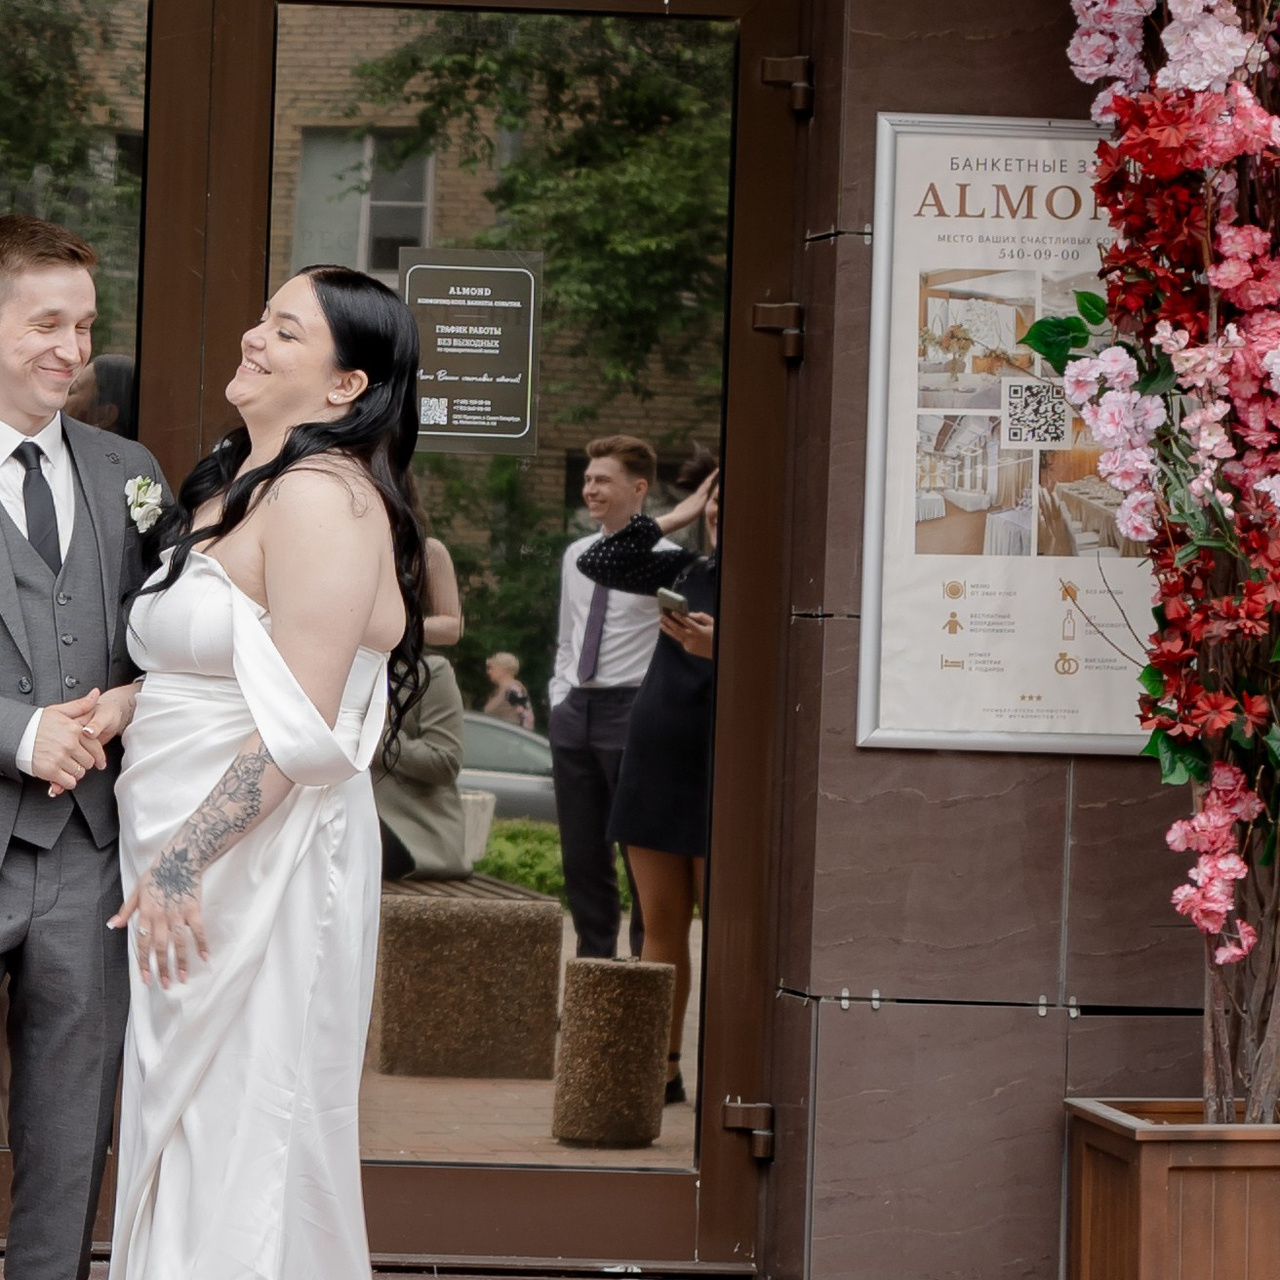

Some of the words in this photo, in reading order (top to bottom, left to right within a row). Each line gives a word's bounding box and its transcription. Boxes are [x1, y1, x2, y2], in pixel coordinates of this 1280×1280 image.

[950, 157, 1068, 173] БАНКЕТНЫЕ
[913, 182, 1102, 220] ALMO
[937, 235, 973, 243] МЕСТО
[978, 235, 1017, 244] ВАШИХ
[1021, 235, 1091, 245] СЧАСТЛИВЫХ
[998, 248, 1080, 260] 540-09-00
[448, 286, 492, 296] ALMOND
[468, 325, 502, 335] РАБОТЫ
[452, 337, 499, 348] ВЫХОДНЫХ
